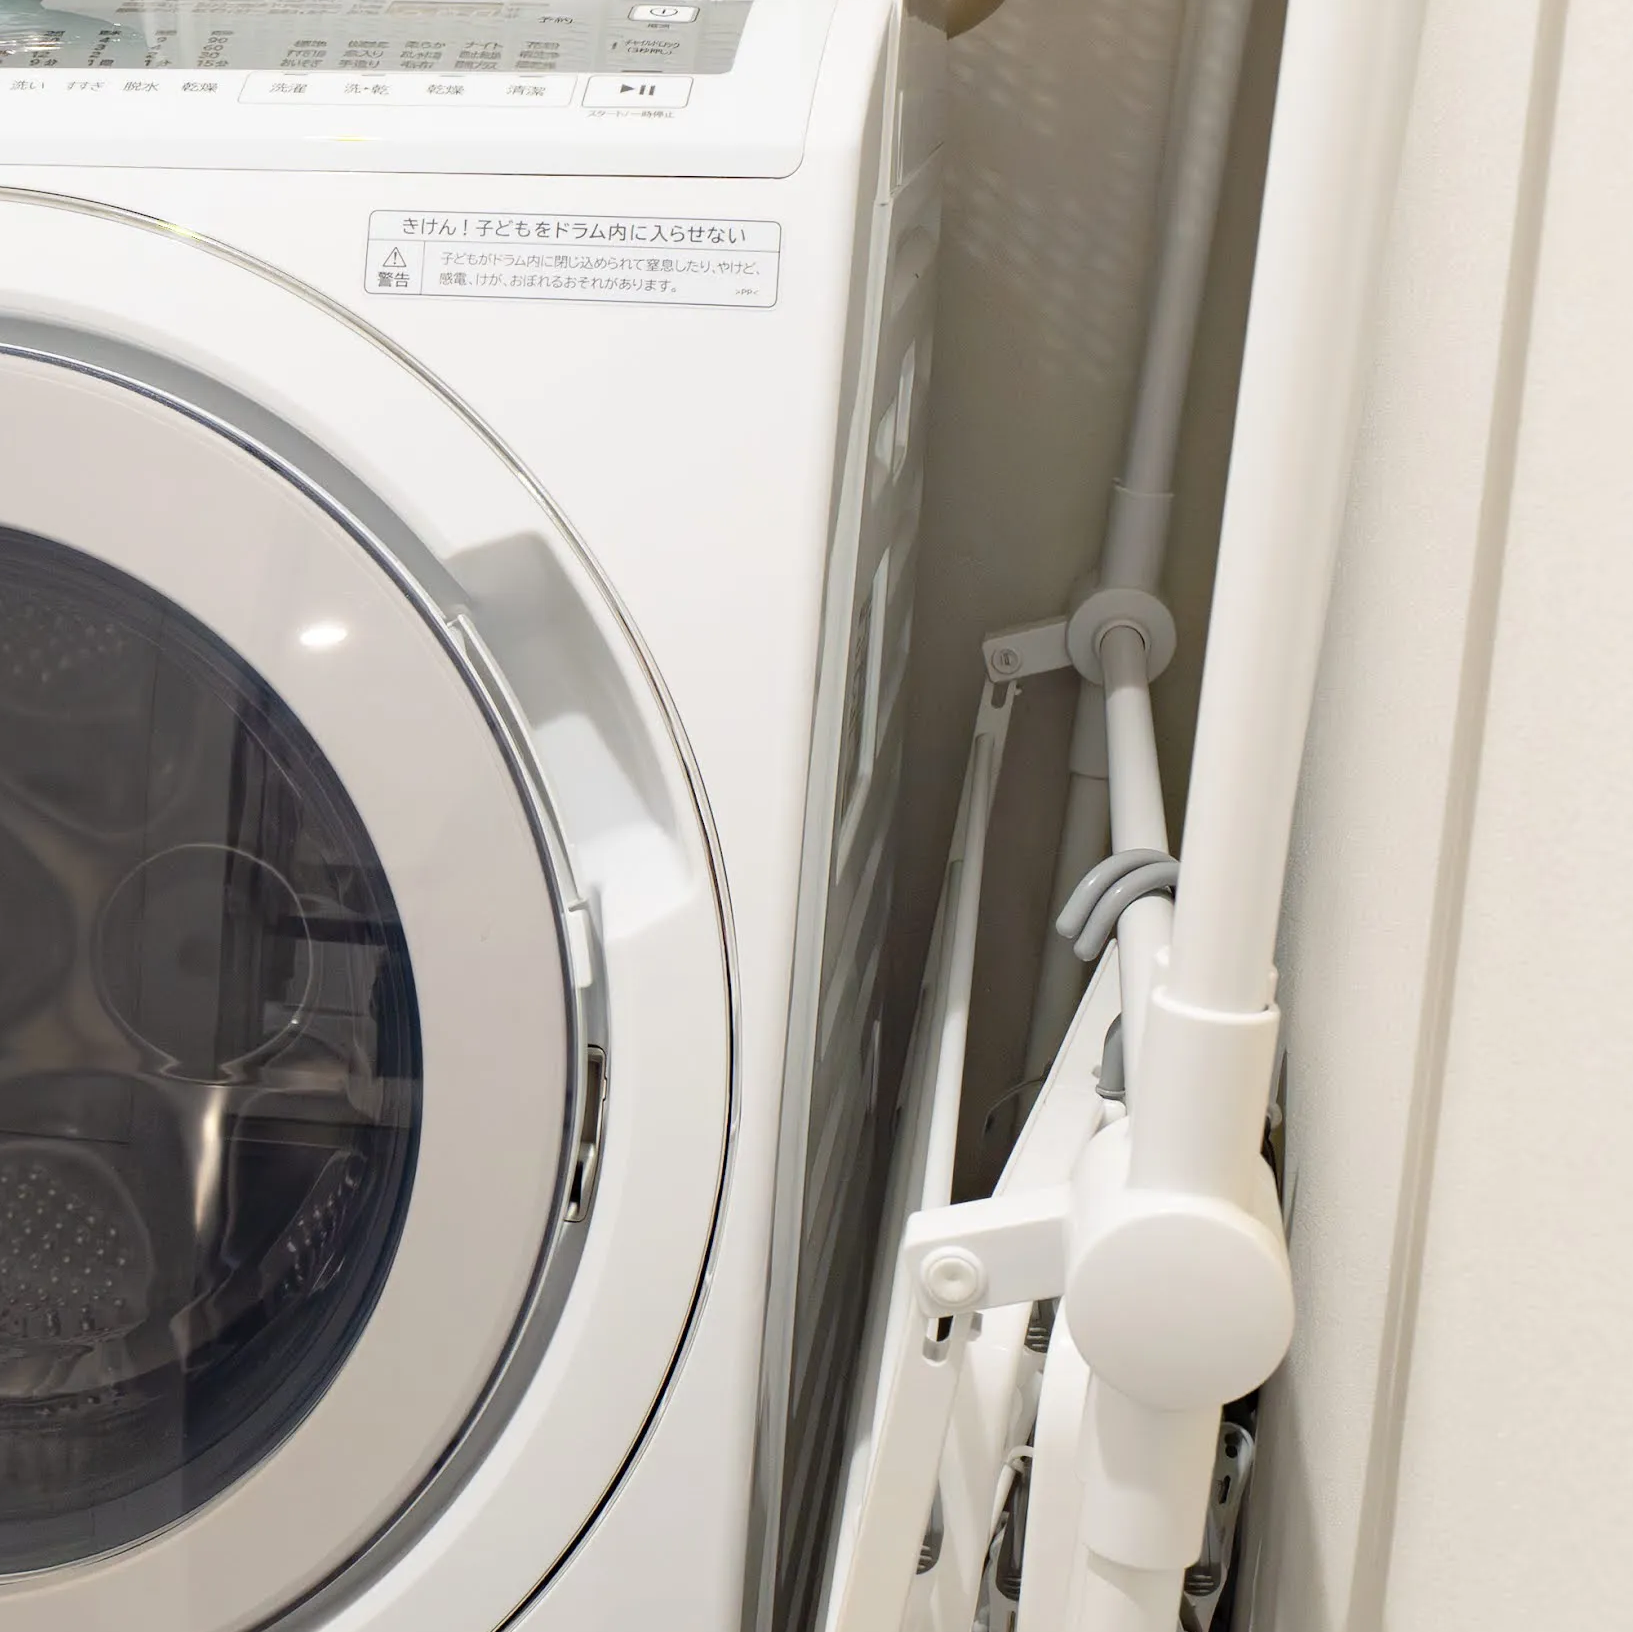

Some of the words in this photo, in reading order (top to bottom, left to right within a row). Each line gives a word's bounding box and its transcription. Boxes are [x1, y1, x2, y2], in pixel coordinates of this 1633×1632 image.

[9, 80, 46, 91] 洗い
[67, 81, 106, 92] すすぎ
[123, 80, 161, 92] 脱水
[181, 82, 219, 93] 乾燥
[269, 82, 308, 94] 洗濯
[427, 84, 465, 96] 乾燥
[377, 271, 410, 288] 警告
